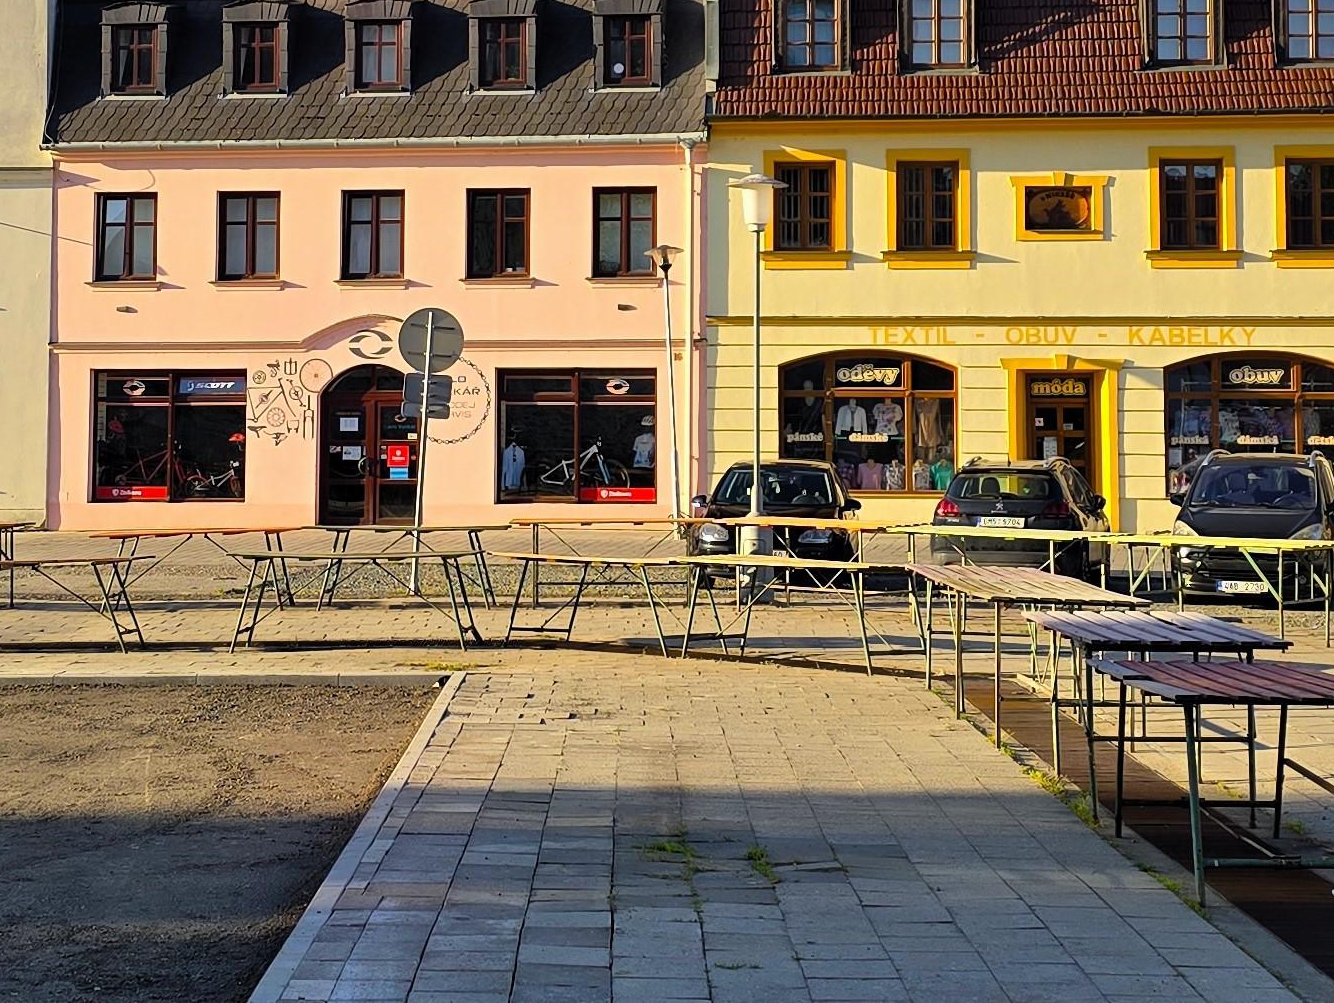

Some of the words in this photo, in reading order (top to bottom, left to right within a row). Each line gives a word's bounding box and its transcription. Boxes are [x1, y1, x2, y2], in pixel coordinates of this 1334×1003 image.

[868, 326, 956, 345] TEXTIL
[1005, 326, 1077, 345] OBUV
[1128, 326, 1257, 346] KABELKY
[837, 363, 899, 385] oděvy
[1229, 365, 1284, 384] obuv
[195, 381, 236, 389] SCOTT
